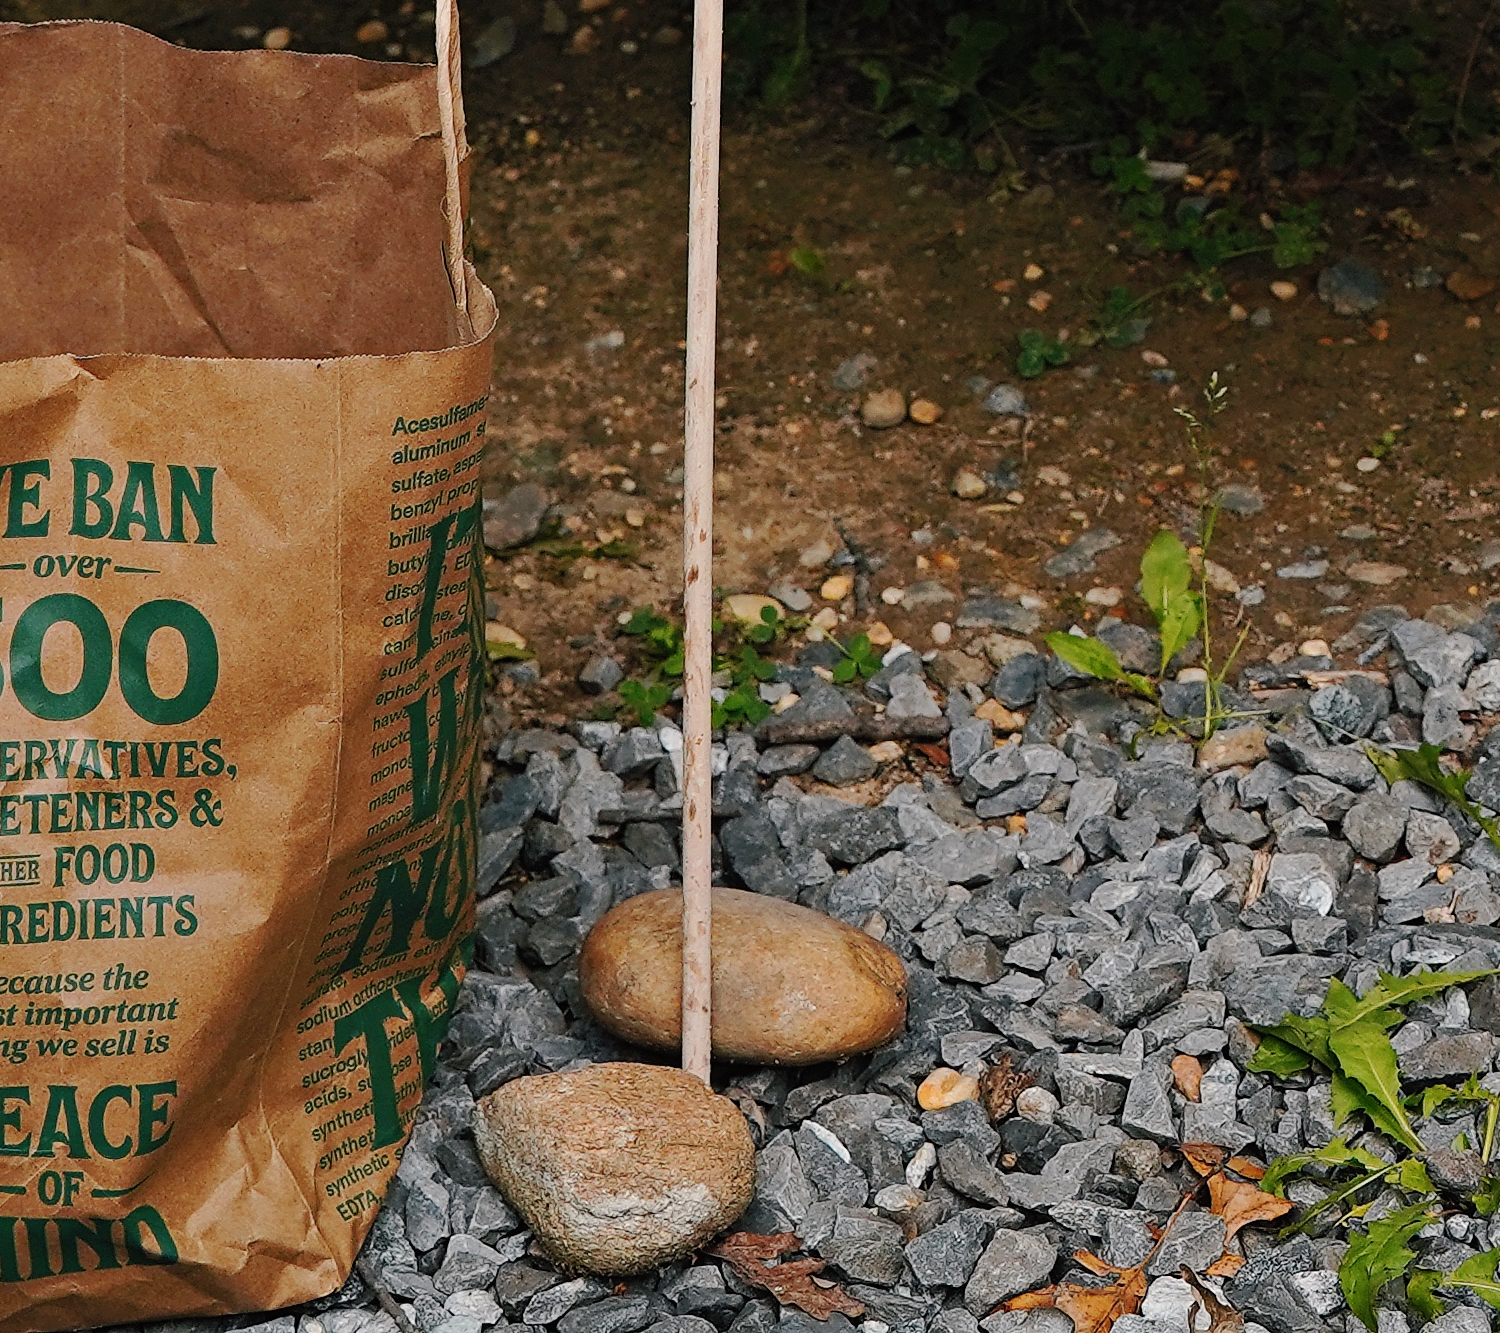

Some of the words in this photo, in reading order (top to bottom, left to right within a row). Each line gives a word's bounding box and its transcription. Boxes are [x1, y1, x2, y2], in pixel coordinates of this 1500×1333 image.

[391, 430, 471, 465] aluminum
[390, 466, 452, 494] sulfate,
[70, 457, 218, 545] BAN
[390, 489, 444, 521] benzyl
[33, 552, 113, 580] over
[189, 787, 225, 829] &
[52, 842, 156, 888] FOOD
[103, 963, 150, 991] the
[24, 997, 180, 1032] important
[296, 998, 352, 1035] sodium
[35, 1037, 79, 1057] we
[85, 1029, 137, 1058] sell
[143, 1029, 171, 1054] is
[304, 1085, 353, 1115] acids,
[311, 1100, 374, 1143] syntheti
[319, 1127, 376, 1171] synthet
[37, 1170, 85, 1208] OF
[325, 1152, 391, 1198] synthetic
